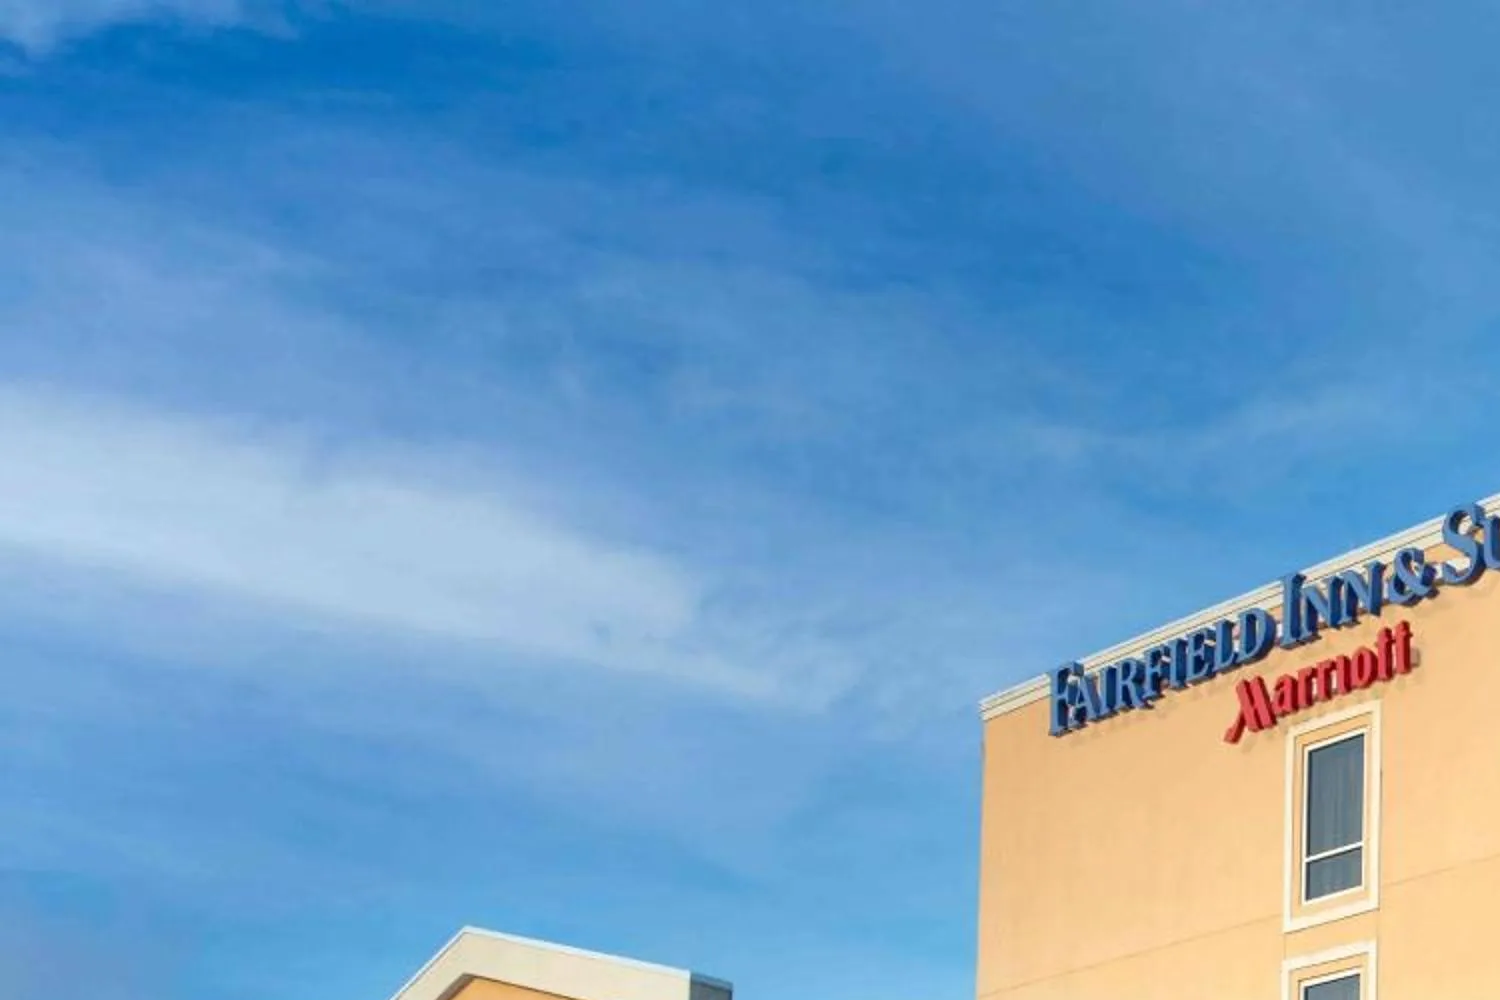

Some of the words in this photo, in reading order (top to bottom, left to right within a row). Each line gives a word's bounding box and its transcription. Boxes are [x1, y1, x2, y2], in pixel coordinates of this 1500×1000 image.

[1048, 608, 1276, 736] FAIRFIELD
[1282, 572, 1384, 648] INN
[1386, 547, 1437, 607] &
[1224, 619, 1413, 744] Marriott
